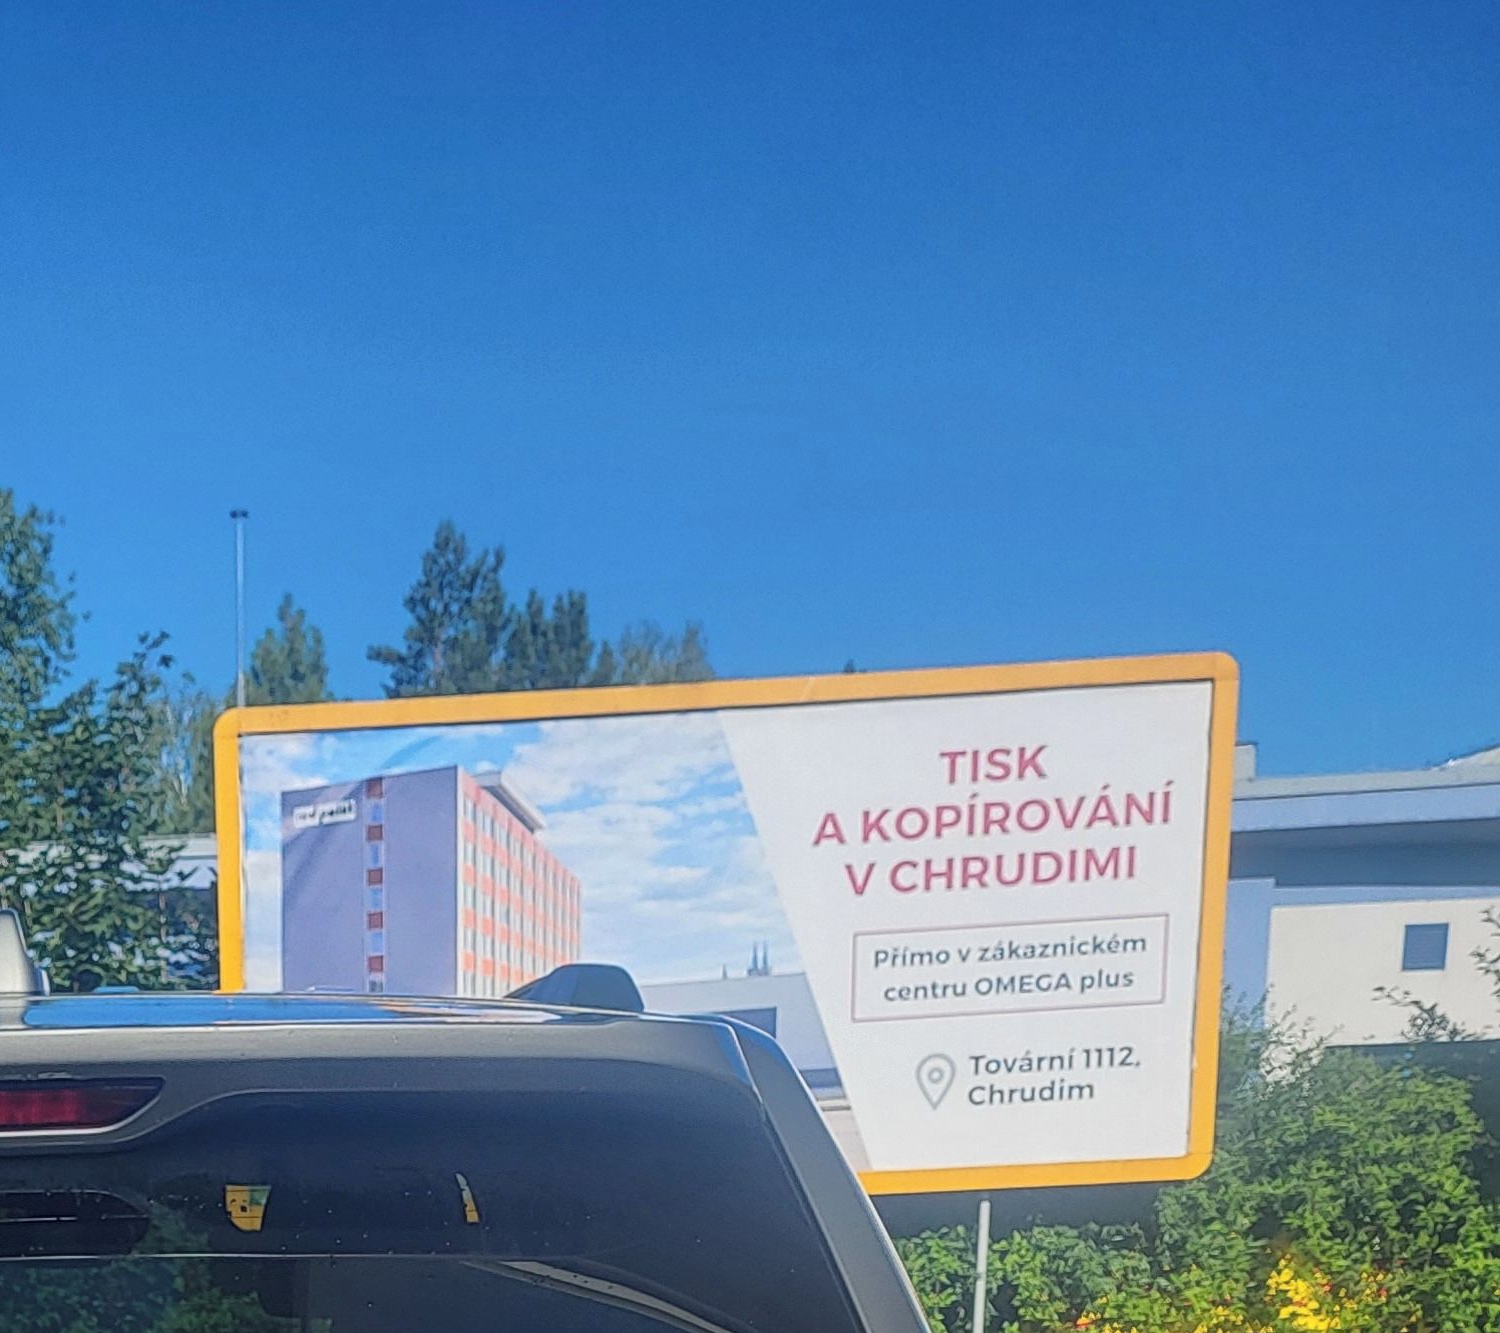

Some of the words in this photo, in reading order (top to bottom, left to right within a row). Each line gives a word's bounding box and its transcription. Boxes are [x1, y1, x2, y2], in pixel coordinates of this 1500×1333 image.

[939, 744, 1048, 785] TISK
[812, 811, 847, 847] A
[861, 779, 1175, 844] KOPÍROVÁNÍ
[844, 861, 877, 896] V
[888, 845, 1137, 894] CHRUDIMI
[873, 945, 951, 969] Přímo
[956, 948, 971, 964] v
[976, 932, 1148, 962] zákaznickém
[883, 977, 967, 1002] centru
[974, 971, 1072, 996] OMEGA
[1079, 968, 1135, 995] plus
[969, 1044, 1074, 1077] Tovární
[967, 1079, 1095, 1106] Chrudim
